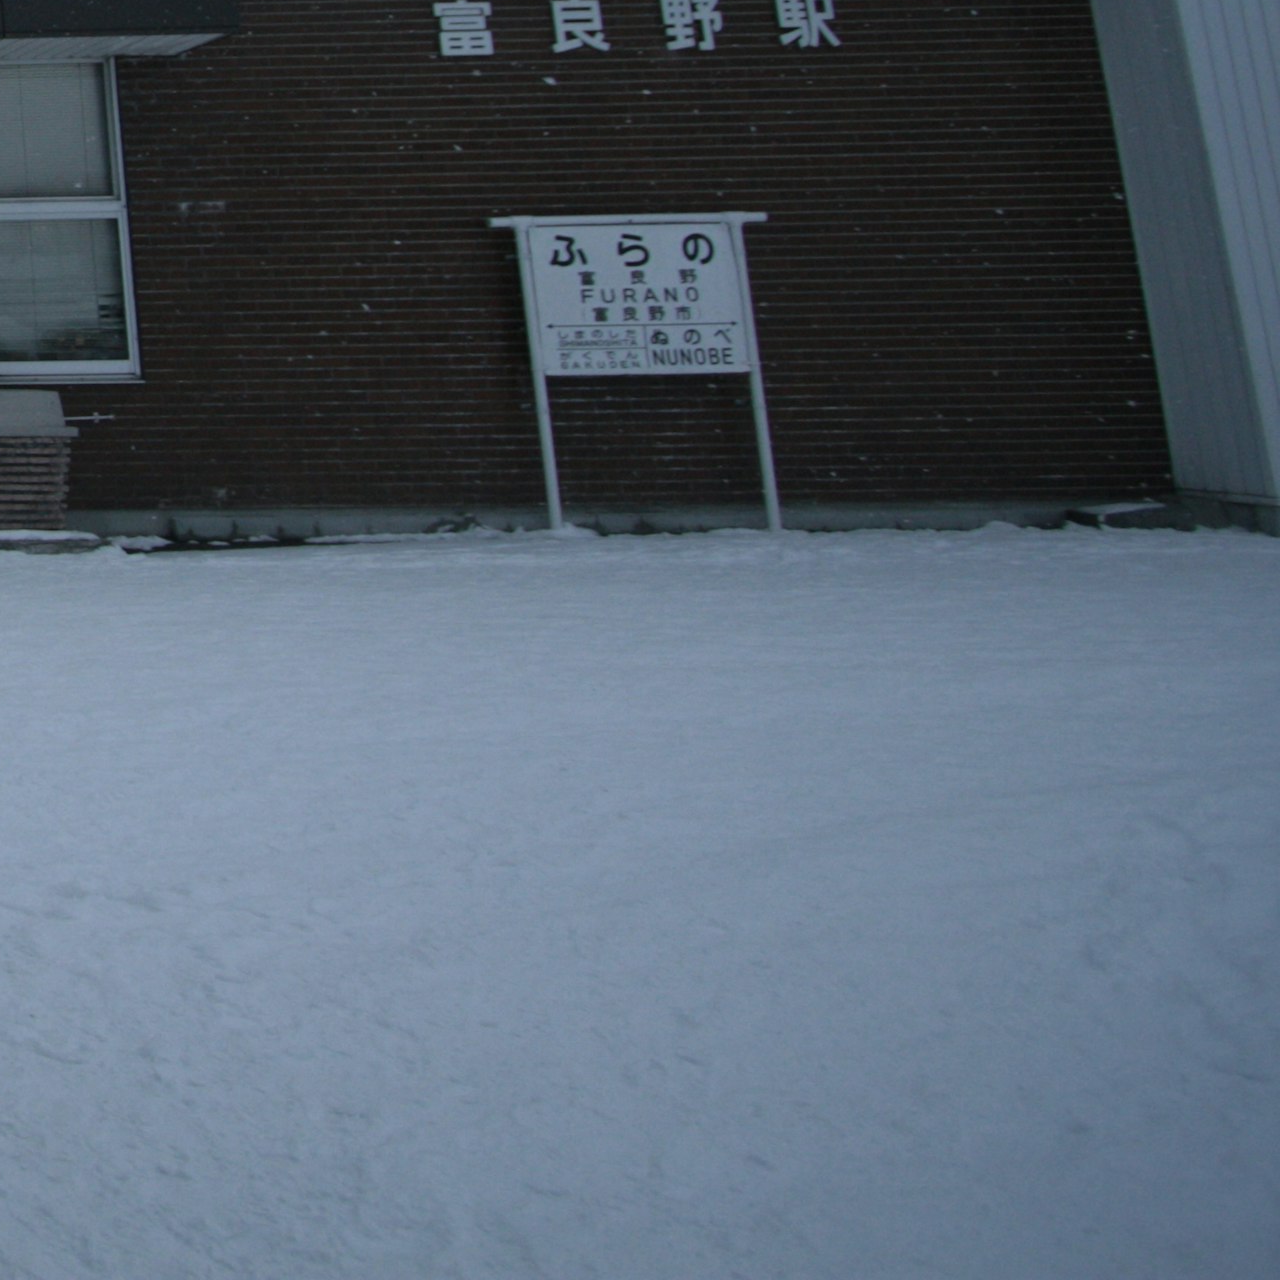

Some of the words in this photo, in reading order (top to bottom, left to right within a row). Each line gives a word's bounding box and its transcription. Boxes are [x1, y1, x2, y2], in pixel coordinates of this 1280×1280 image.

[549, 233, 714, 266] ふらの
[578, 269, 698, 286] 富良野
[580, 286, 700, 304] FURANO
[650, 329, 733, 345] ぬのべ
[652, 347, 735, 366] NUNOBE
